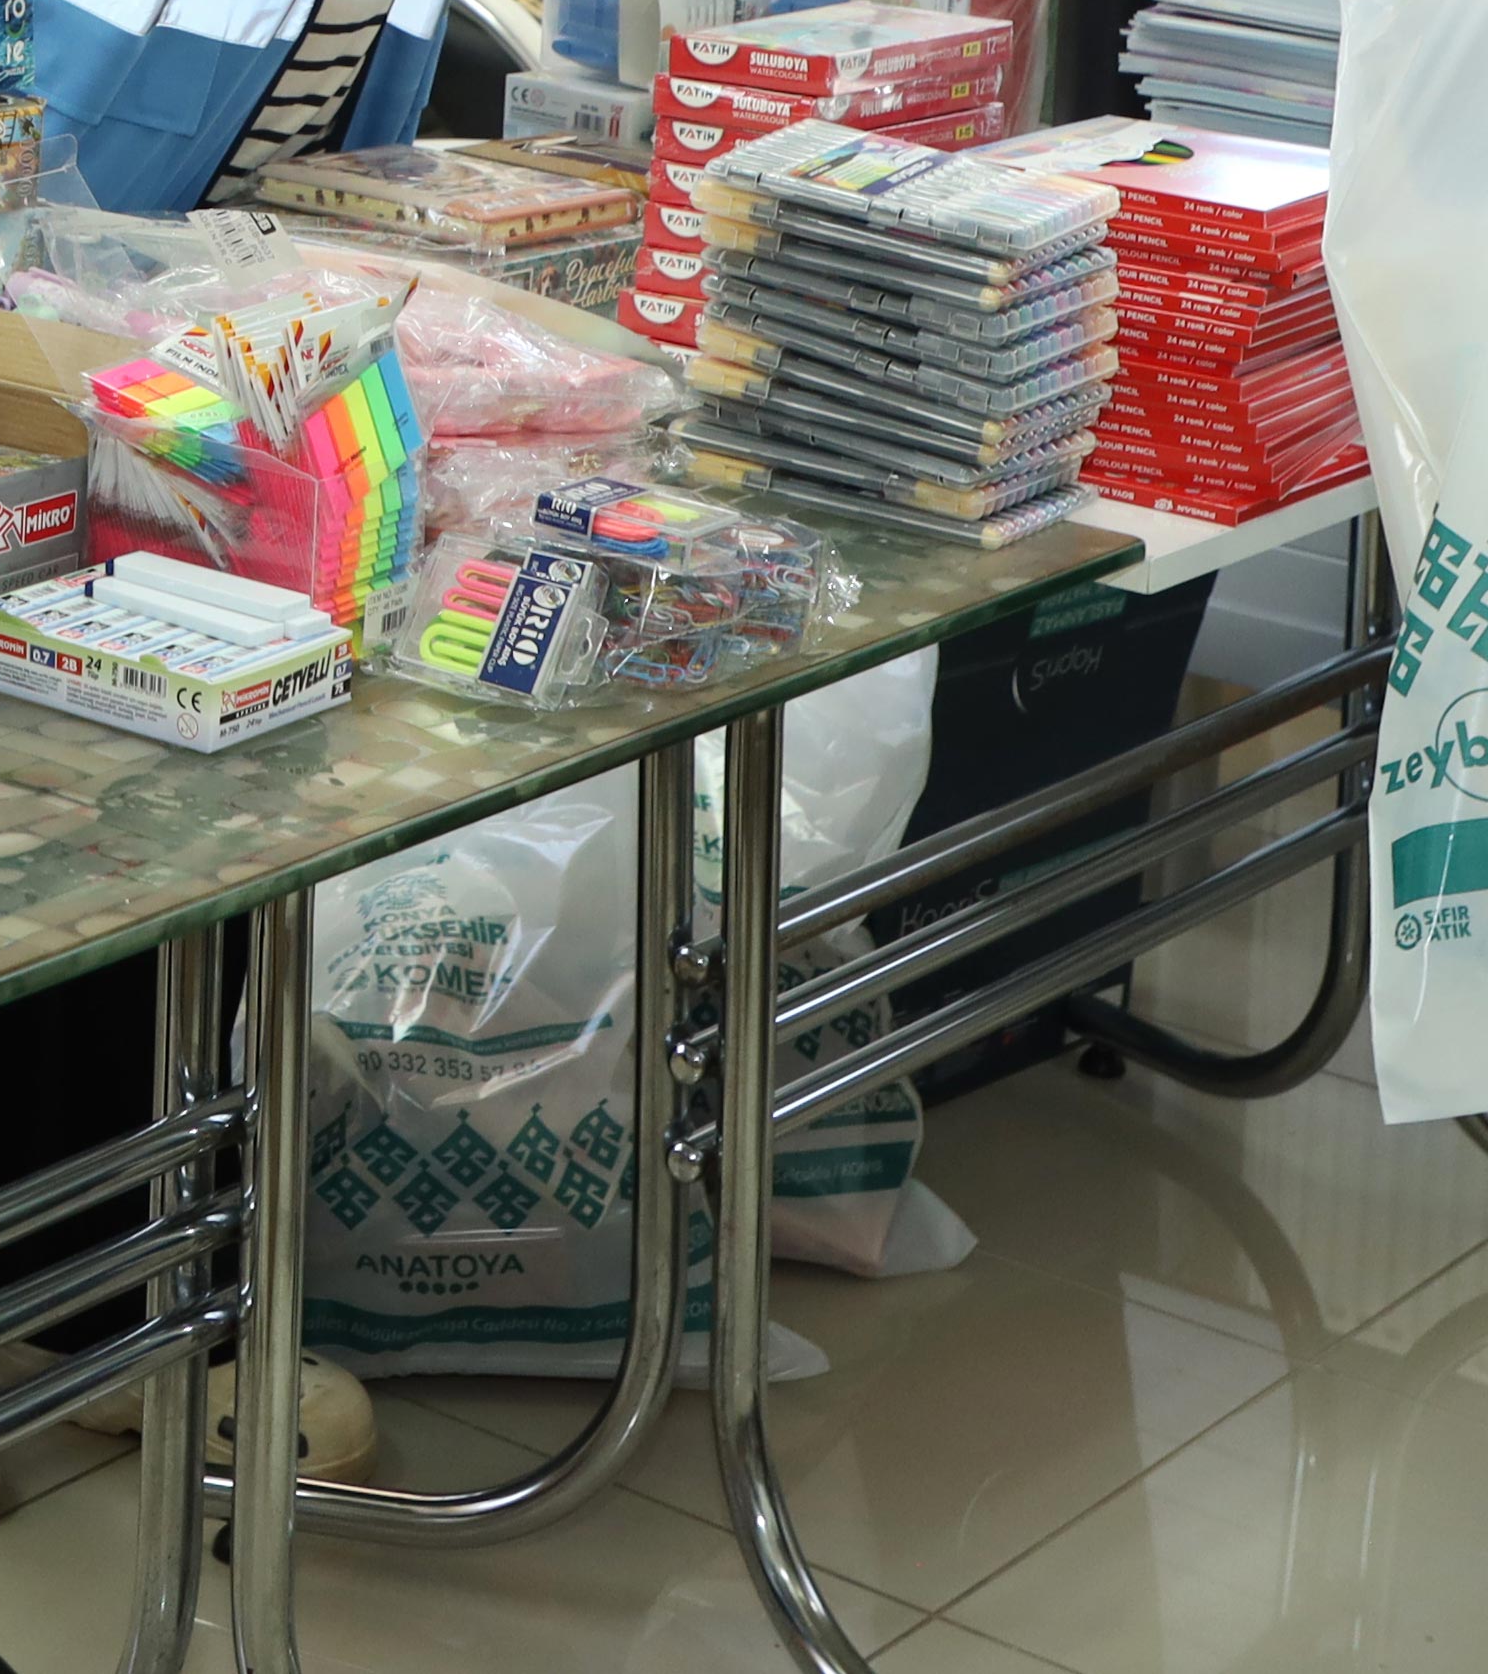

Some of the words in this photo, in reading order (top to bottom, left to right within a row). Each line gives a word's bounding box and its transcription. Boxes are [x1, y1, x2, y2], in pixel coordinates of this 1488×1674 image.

[750, 51, 808, 72] SULUBOYA
[750, 68, 808, 83] WATERCOLOURS
[732, 96, 791, 117] SULUBOYA
[26, 507, 71, 535] MİKRO
[32, 648, 51, 665] 0.7
[61, 657, 77, 673] 2B
[85, 655, 103, 673] 24
[388, 1051, 427, 1075] 332
[433, 1056, 474, 1081] 353
[355, 1253, 526, 1280] ANATOYA
